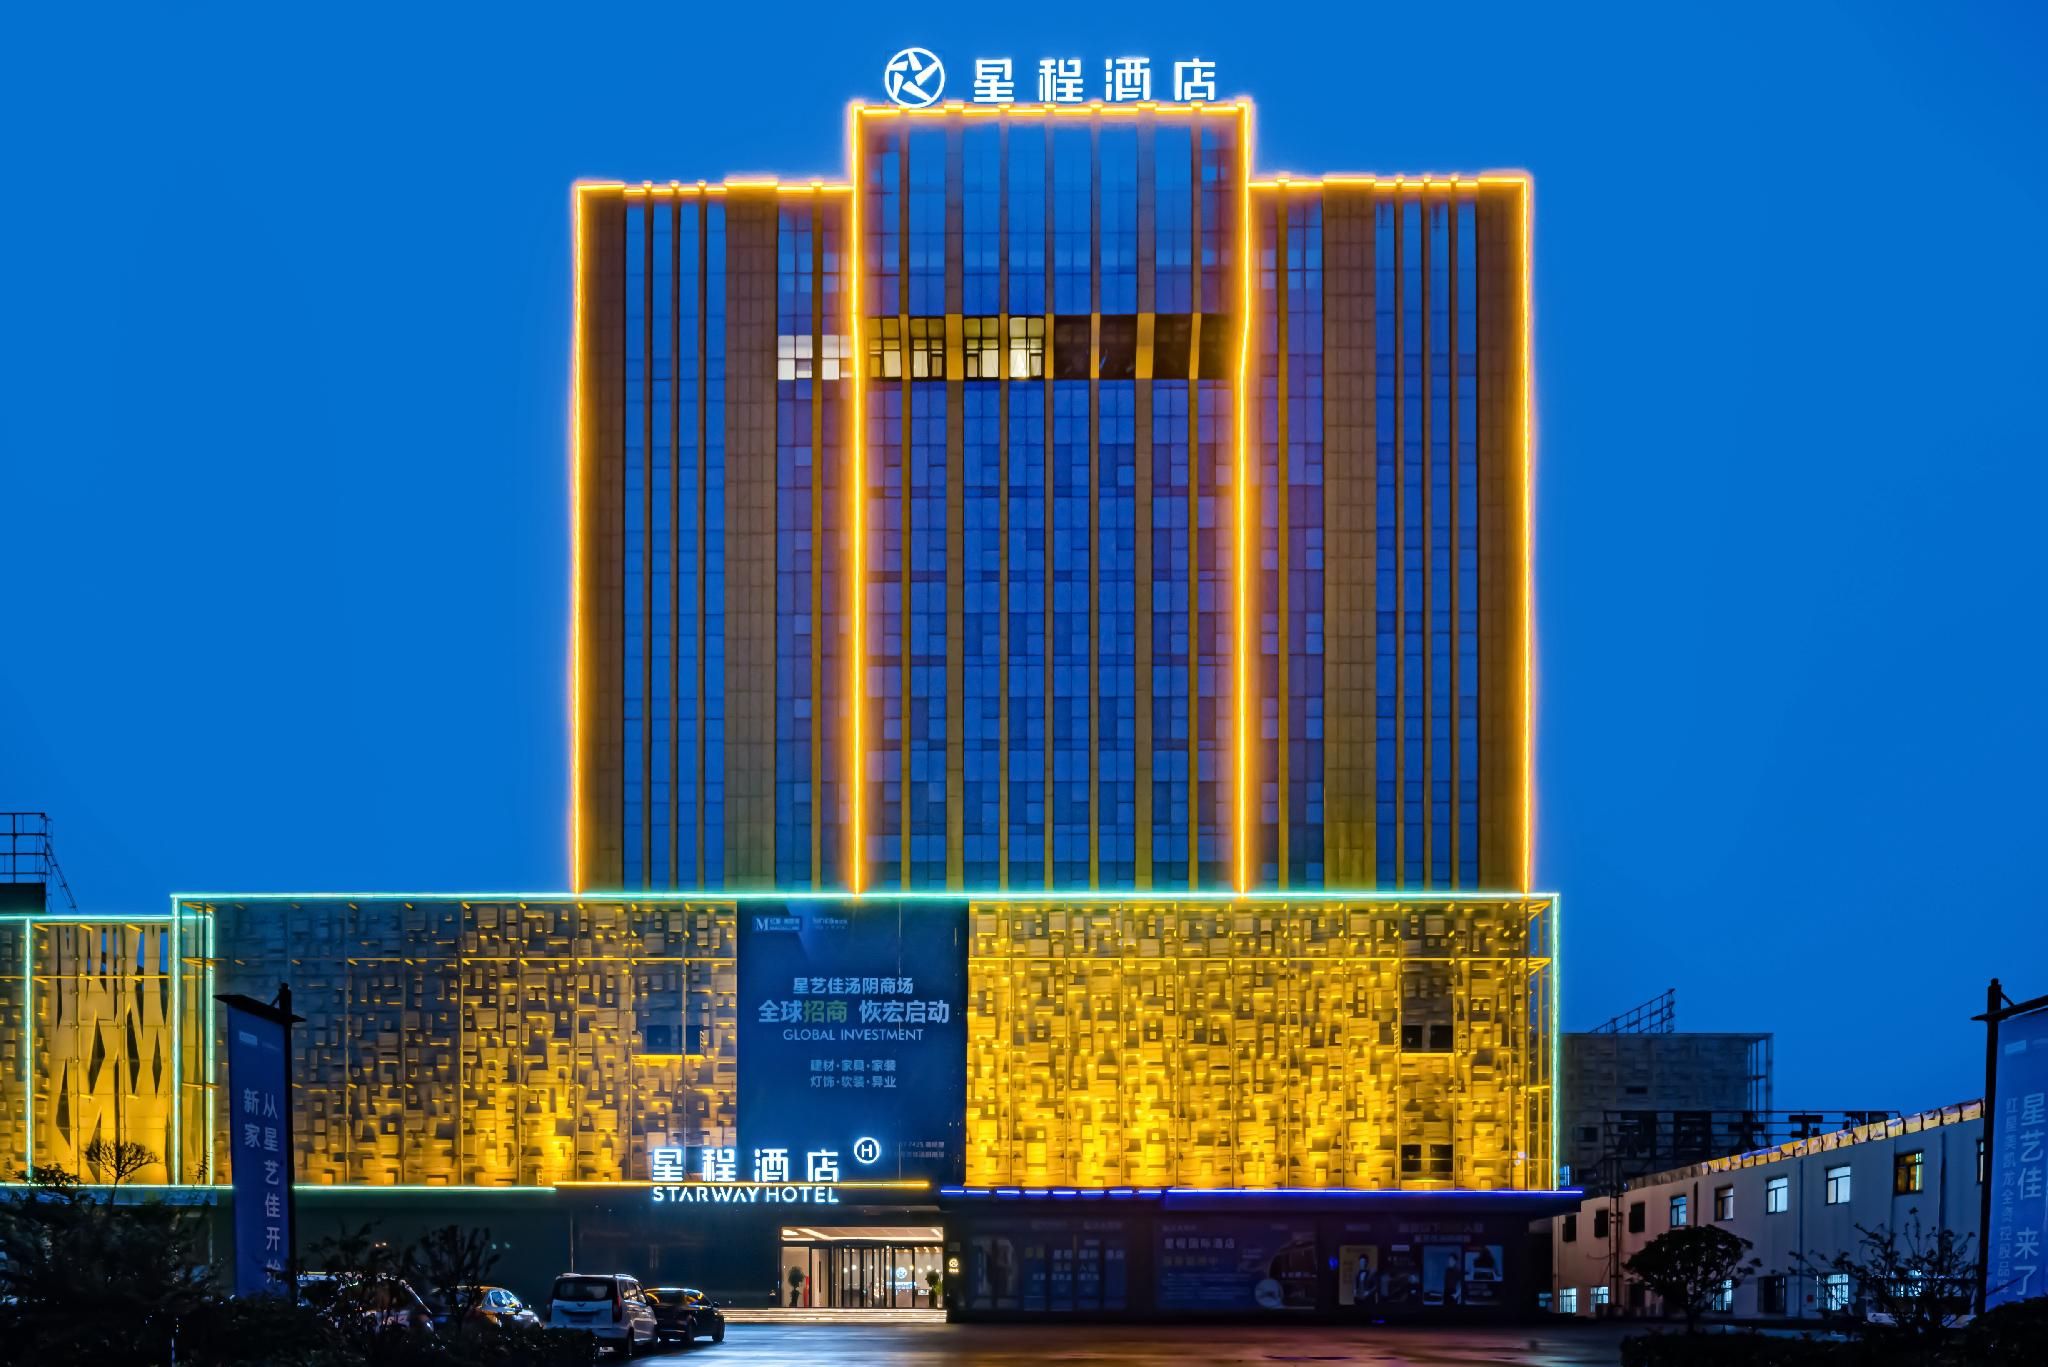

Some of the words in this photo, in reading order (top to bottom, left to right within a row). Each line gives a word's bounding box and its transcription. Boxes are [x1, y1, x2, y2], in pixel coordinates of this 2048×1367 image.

[973, 58, 1216, 103] 星程酒店
[793, 977, 914, 994] 星艺佳汤阴商场
[758, 1000, 848, 1024] 全球招商
[859, 1000, 950, 1024] 恢宏启动
[783, 1028, 836, 1041] GLOBAL
[840, 1028, 924, 1041] INVESTMENT
[243, 1087, 261, 1148] 新家
[2017, 1092, 2047, 1201] 星艺佳
[652, 1148, 839, 1183] 星程酒店
[653, 1186, 759, 1203] STARWAY
[766, 1186, 839, 1203] HOTEL
[2013, 1226, 2040, 1296] 来了
